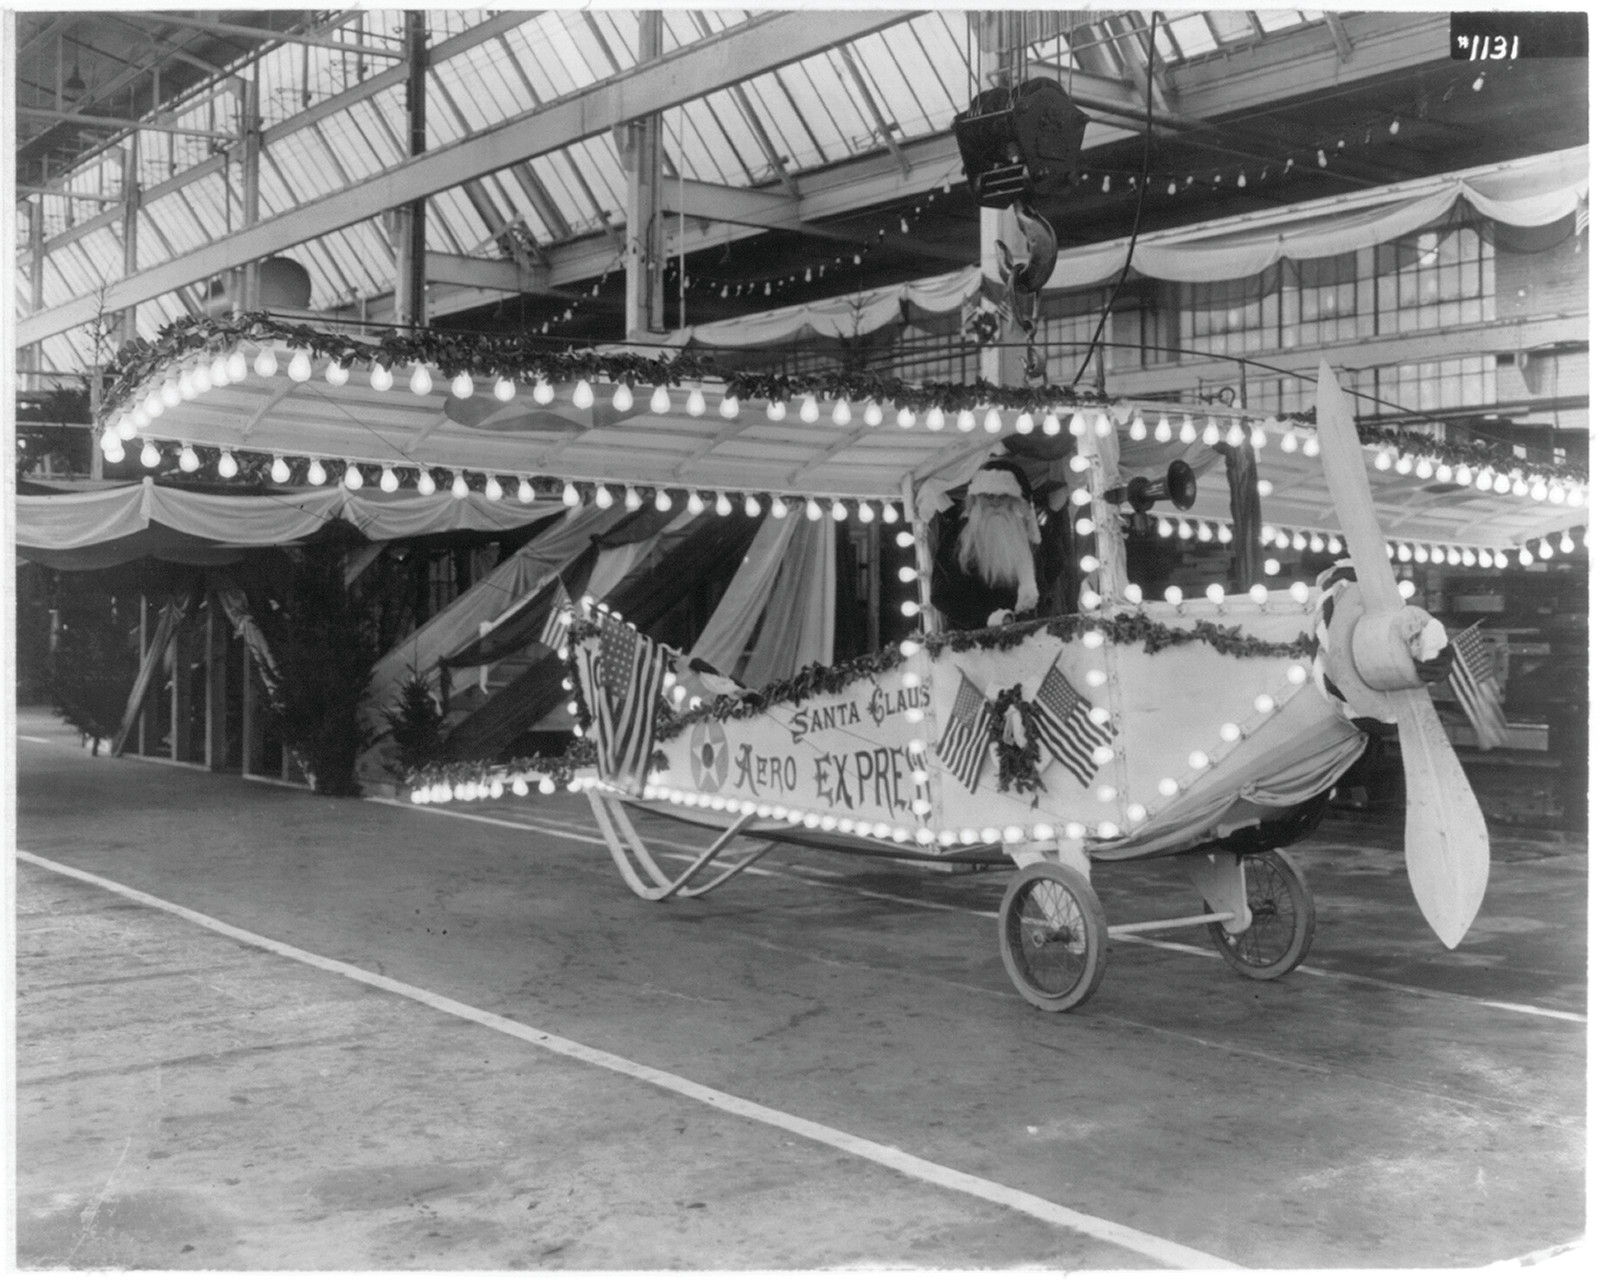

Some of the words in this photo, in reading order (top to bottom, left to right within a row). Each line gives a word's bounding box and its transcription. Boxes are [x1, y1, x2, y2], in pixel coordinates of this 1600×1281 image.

[789, 701, 861, 744] SANTA
[867, 684, 930, 728] CLAUS
[734, 743, 797, 797] AERO
